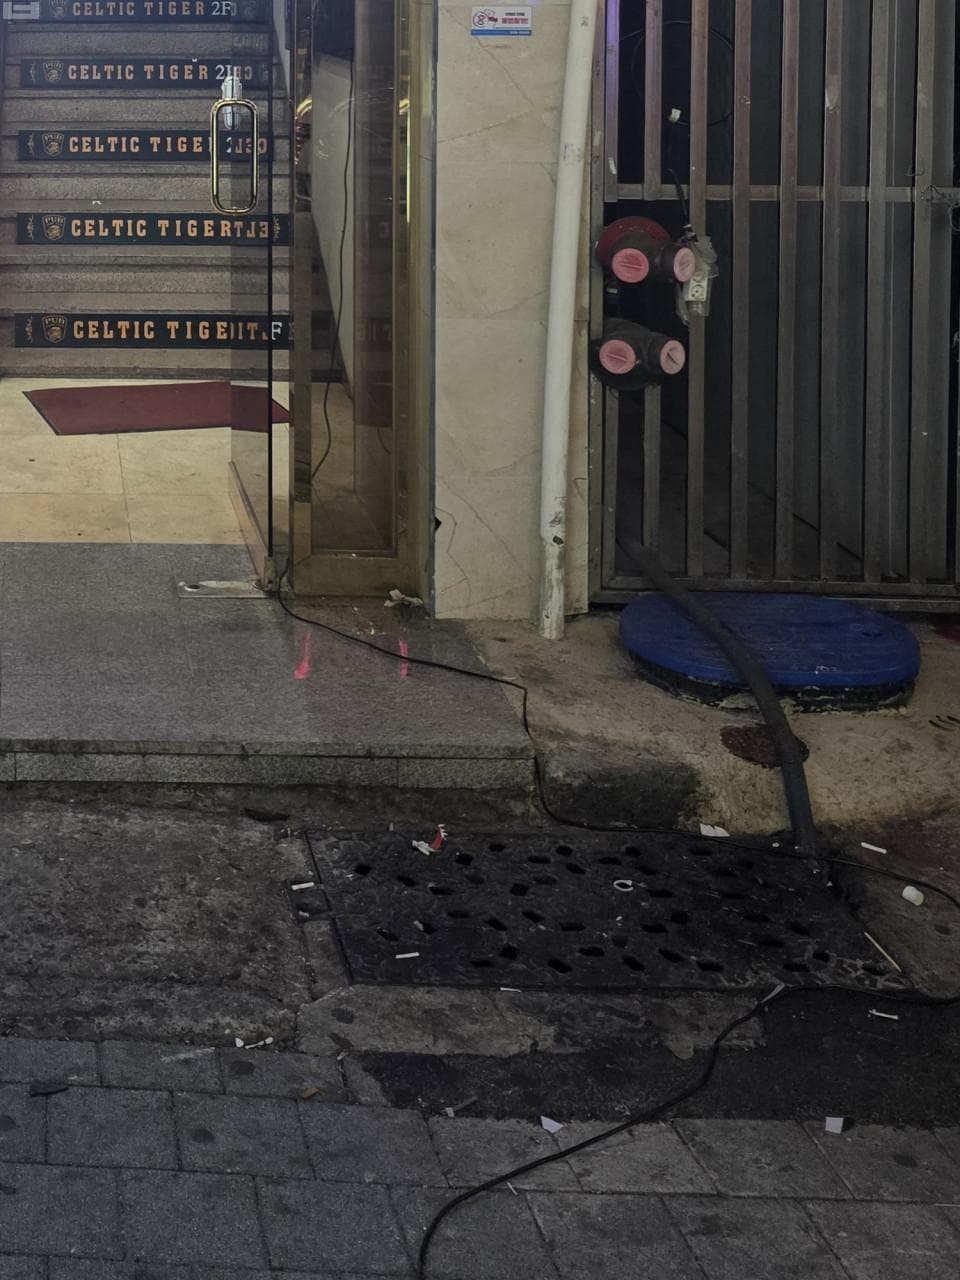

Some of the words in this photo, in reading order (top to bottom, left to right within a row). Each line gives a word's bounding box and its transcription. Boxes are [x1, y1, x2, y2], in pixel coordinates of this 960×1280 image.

[72, 0, 136, 16] CELTIC
[144, 0, 205, 16] TIGER
[211, 0, 233, 16] 2F
[67, 65, 135, 81] CELTIC
[143, 64, 209, 81] TIGER
[68, 136, 140, 153] CELTIC
[150, 136, 213, 153] TIGE
[71, 220, 147, 237] CELTIC
[157, 220, 232, 237] TIGER
[73, 321, 155, 340] CELTIC
[165, 321, 233, 340] TIGE
